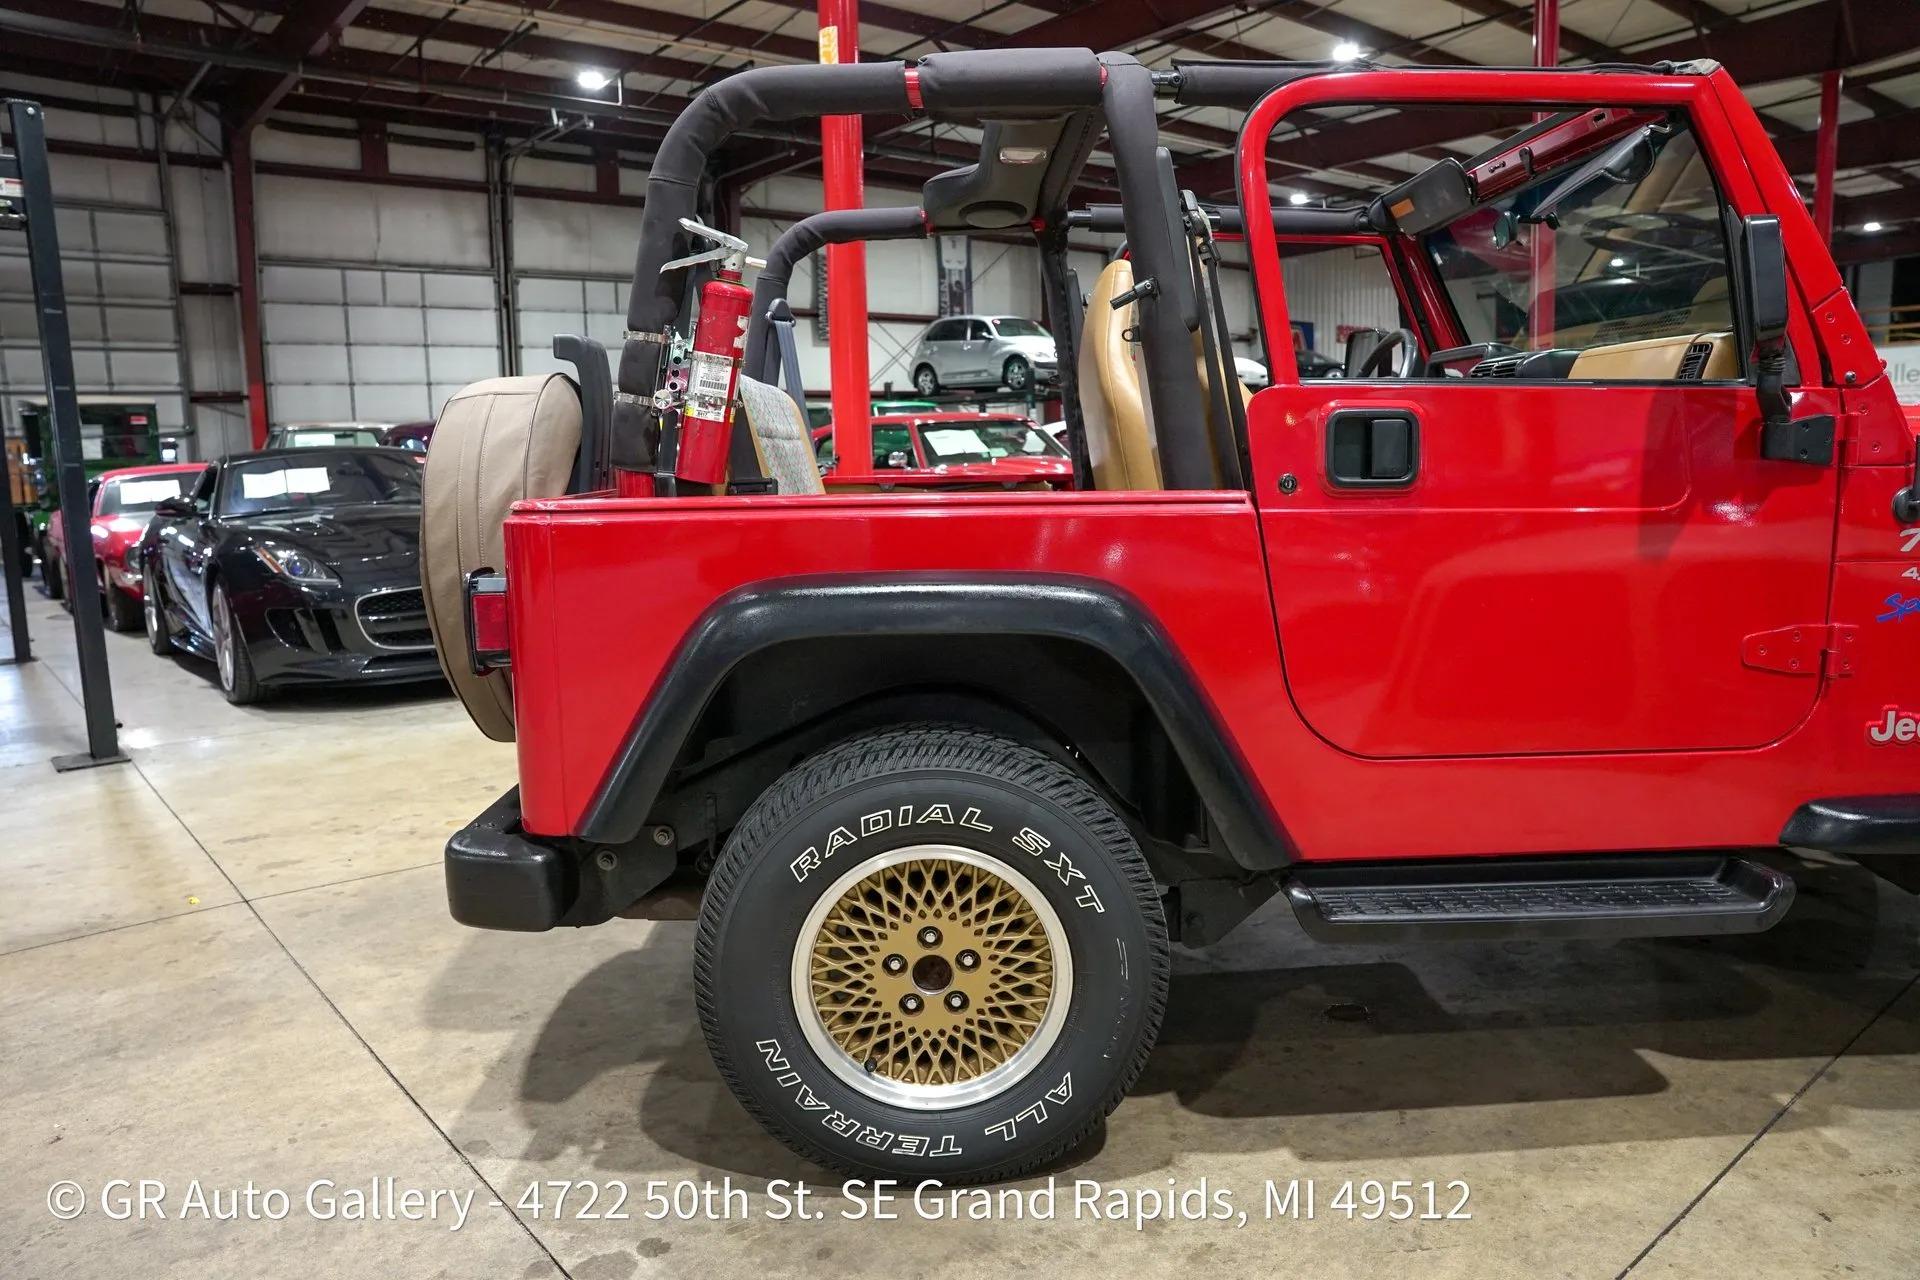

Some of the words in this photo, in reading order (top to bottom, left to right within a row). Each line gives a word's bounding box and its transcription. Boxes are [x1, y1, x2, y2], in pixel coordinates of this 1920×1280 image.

[1888, 363, 1920, 383] lle
[1870, 710, 1920, 742] Je
[790, 803, 994, 883] RADIAL
[1012, 826, 1106, 914] SXT
[756, 1039, 963, 1158] TERRAIN
[984, 1071, 1074, 1142] ALL
